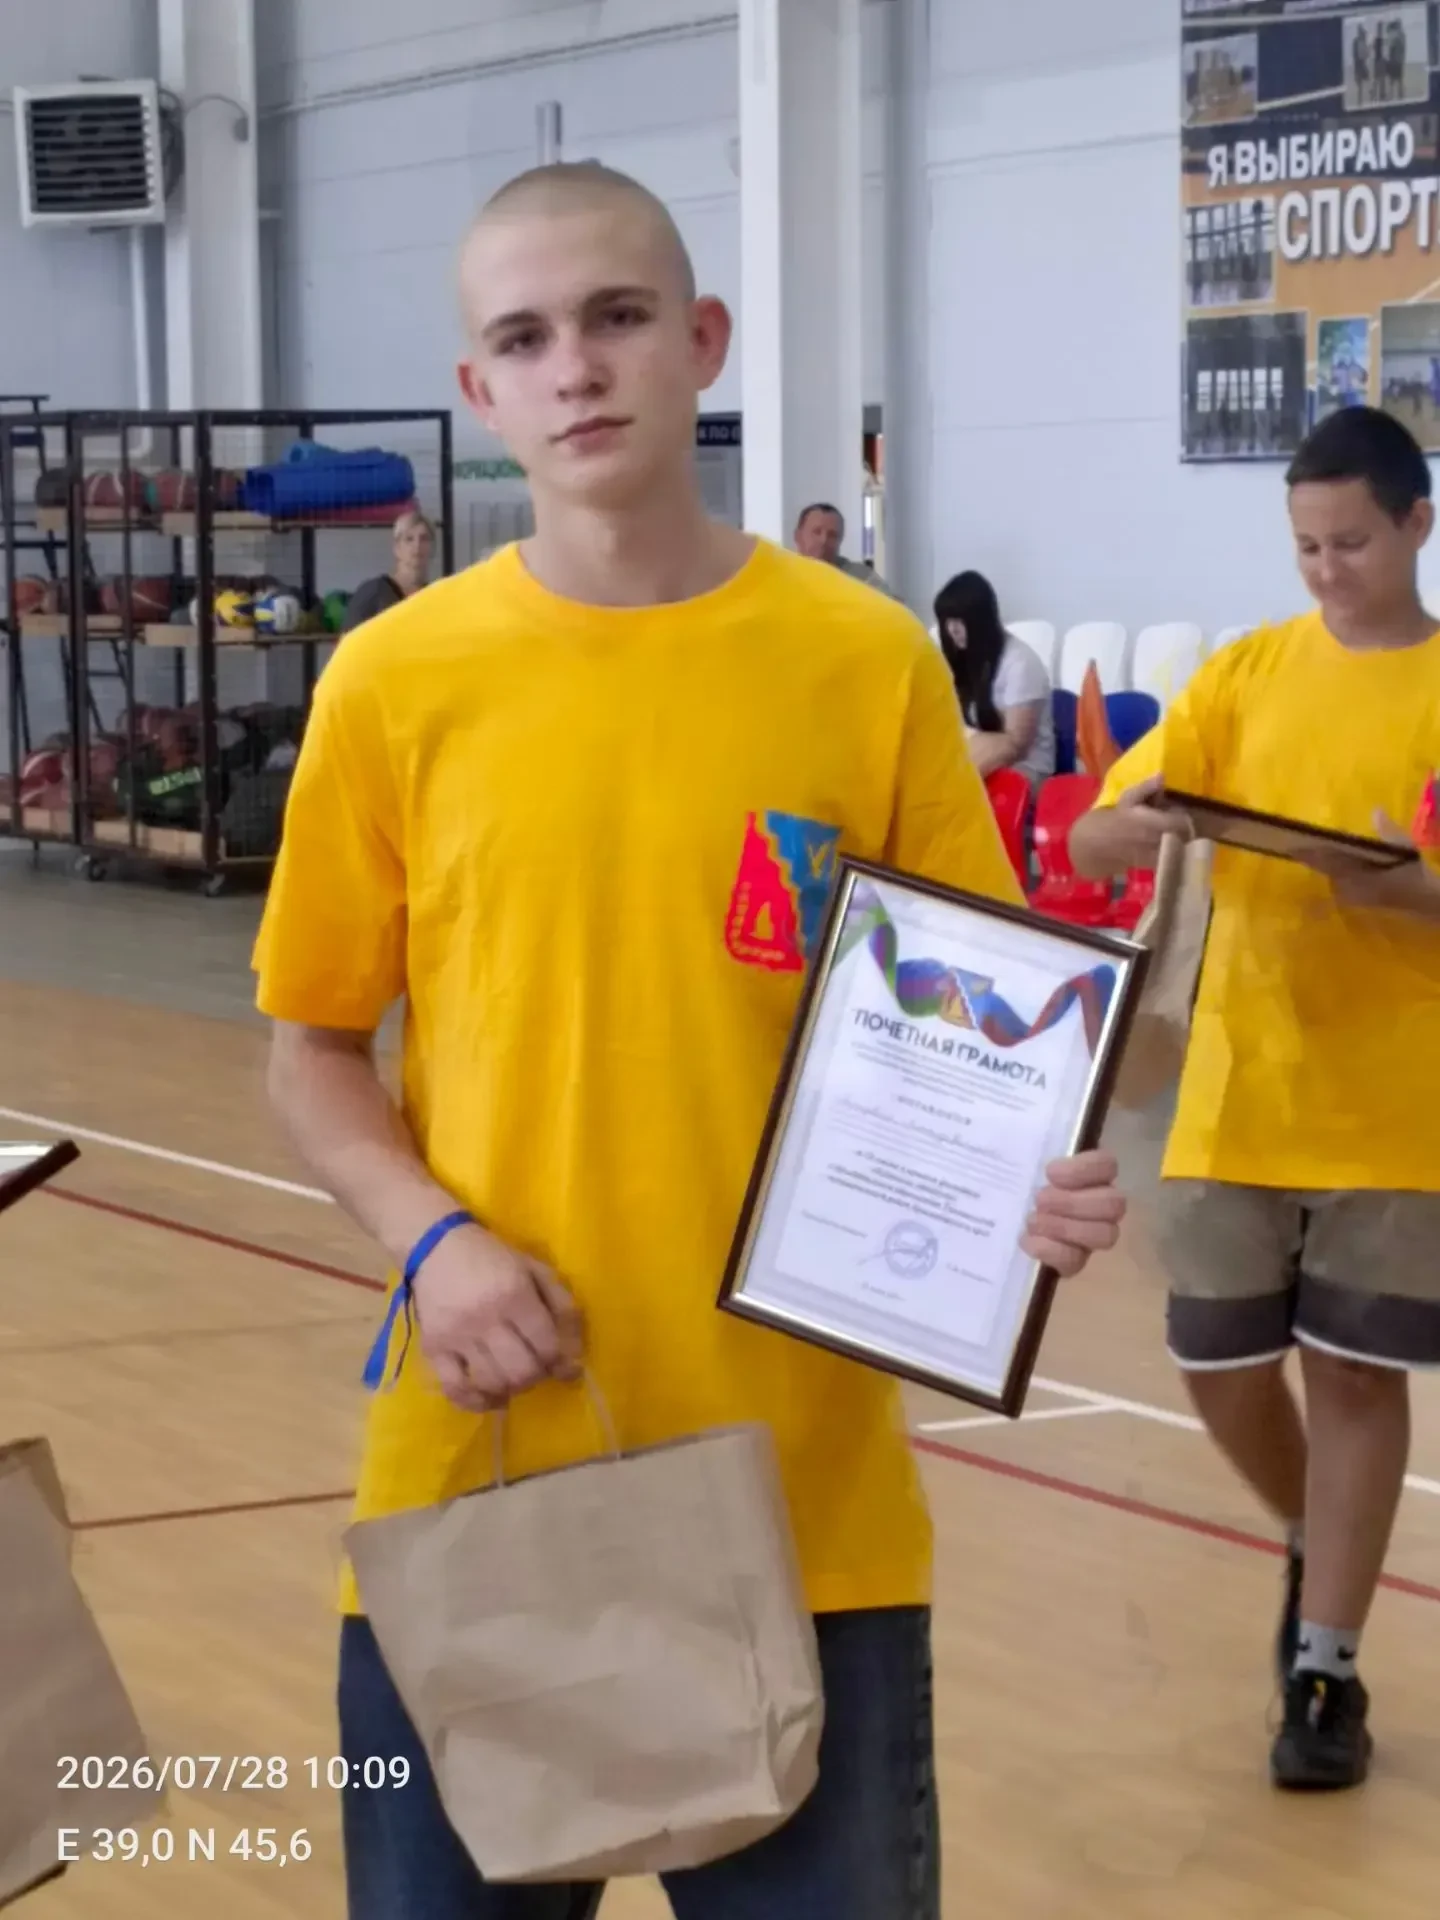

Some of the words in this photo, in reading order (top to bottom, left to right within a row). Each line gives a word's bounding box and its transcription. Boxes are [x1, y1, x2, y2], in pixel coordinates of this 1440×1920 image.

[1207, 144, 1229, 188] Я
[1234, 121, 1415, 185] ВЫБИРАЮ
[1278, 175, 1440, 260] СПОРТ
[852, 1008, 954, 1056] ПОЧЕТНАЯ
[956, 1043, 1047, 1089] ГРАМОТА
